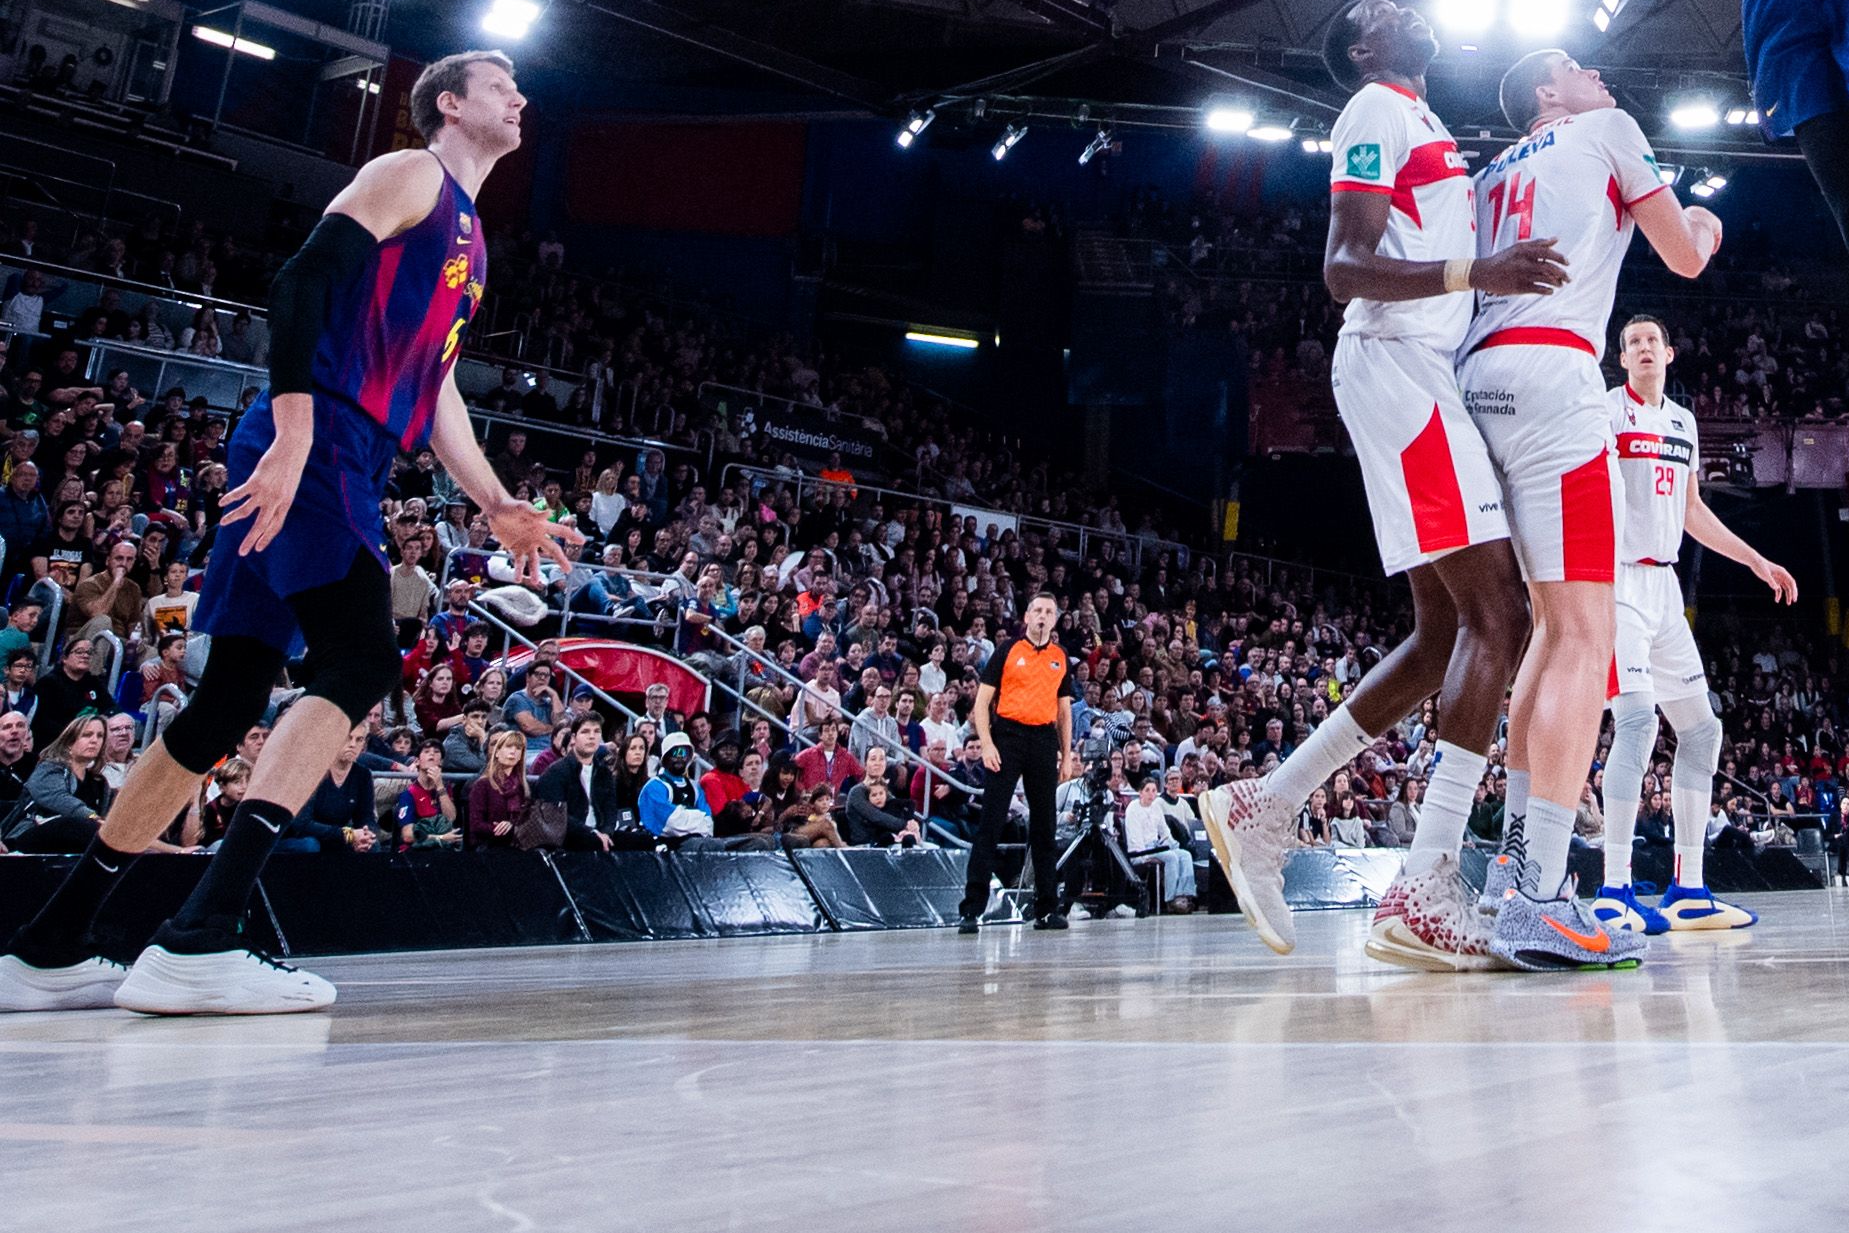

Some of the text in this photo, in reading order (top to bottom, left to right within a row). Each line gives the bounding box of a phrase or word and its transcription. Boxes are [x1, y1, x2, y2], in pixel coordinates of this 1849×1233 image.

[1488, 171, 1536, 247] 14
[441, 317, 466, 363] 6
[1655, 465, 1676, 496] 29
